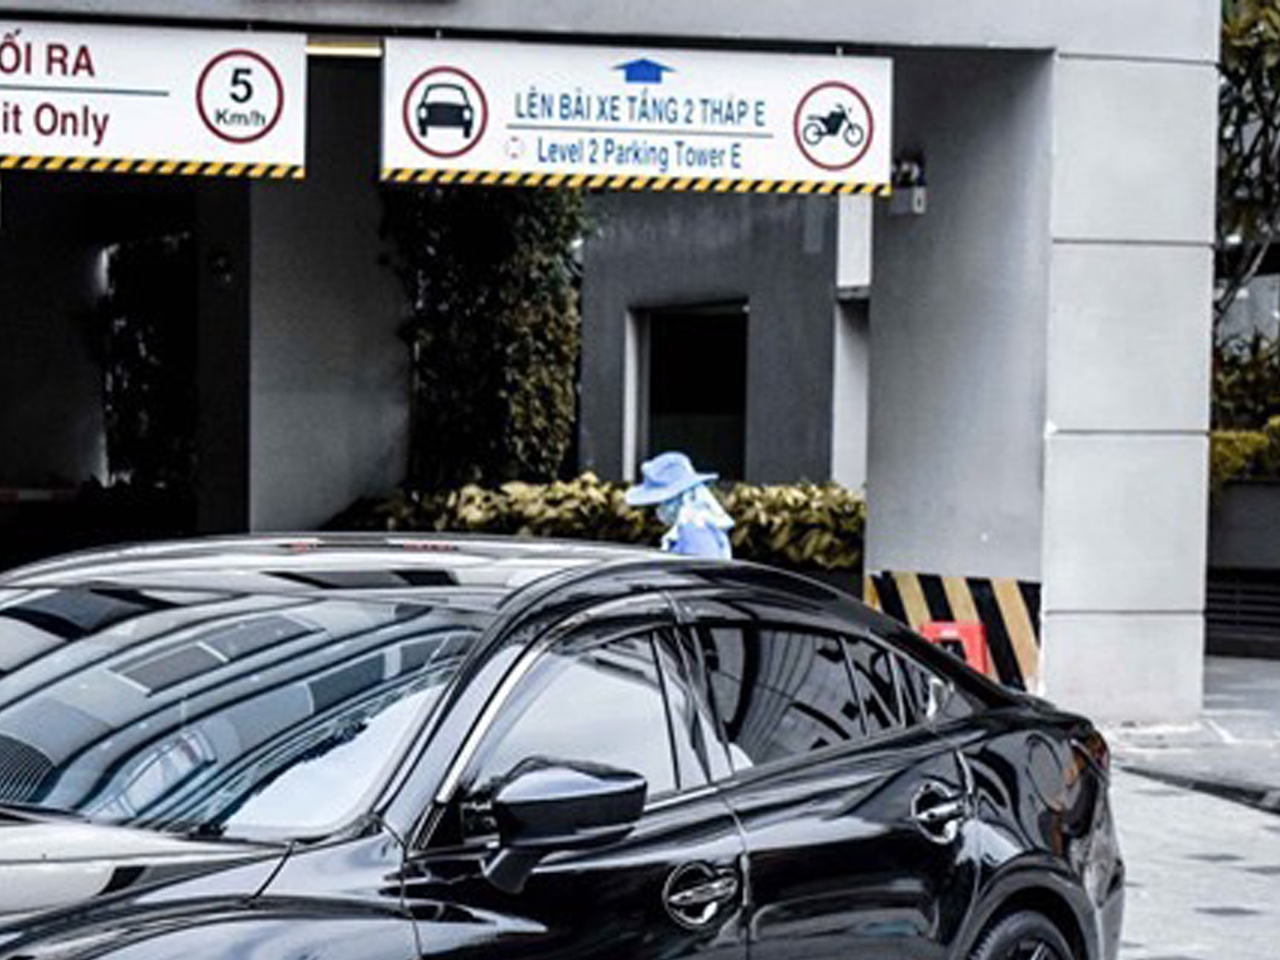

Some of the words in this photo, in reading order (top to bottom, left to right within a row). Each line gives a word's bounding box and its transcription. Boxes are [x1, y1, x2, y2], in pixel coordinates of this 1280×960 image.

[46, 43, 95, 77] RA
[230, 67, 253, 103] 5
[34, 102, 109, 147] Only
[215, 108, 266, 126] Km/h
[596, 95, 621, 121] XE
[683, 98, 694, 123] 2
[754, 101, 766, 126] E
[538, 137, 584, 163] Level
[589, 138, 599, 163] 2
[604, 138, 669, 172] Parking
[674, 140, 726, 167] Tower
[730, 143, 742, 168] E
